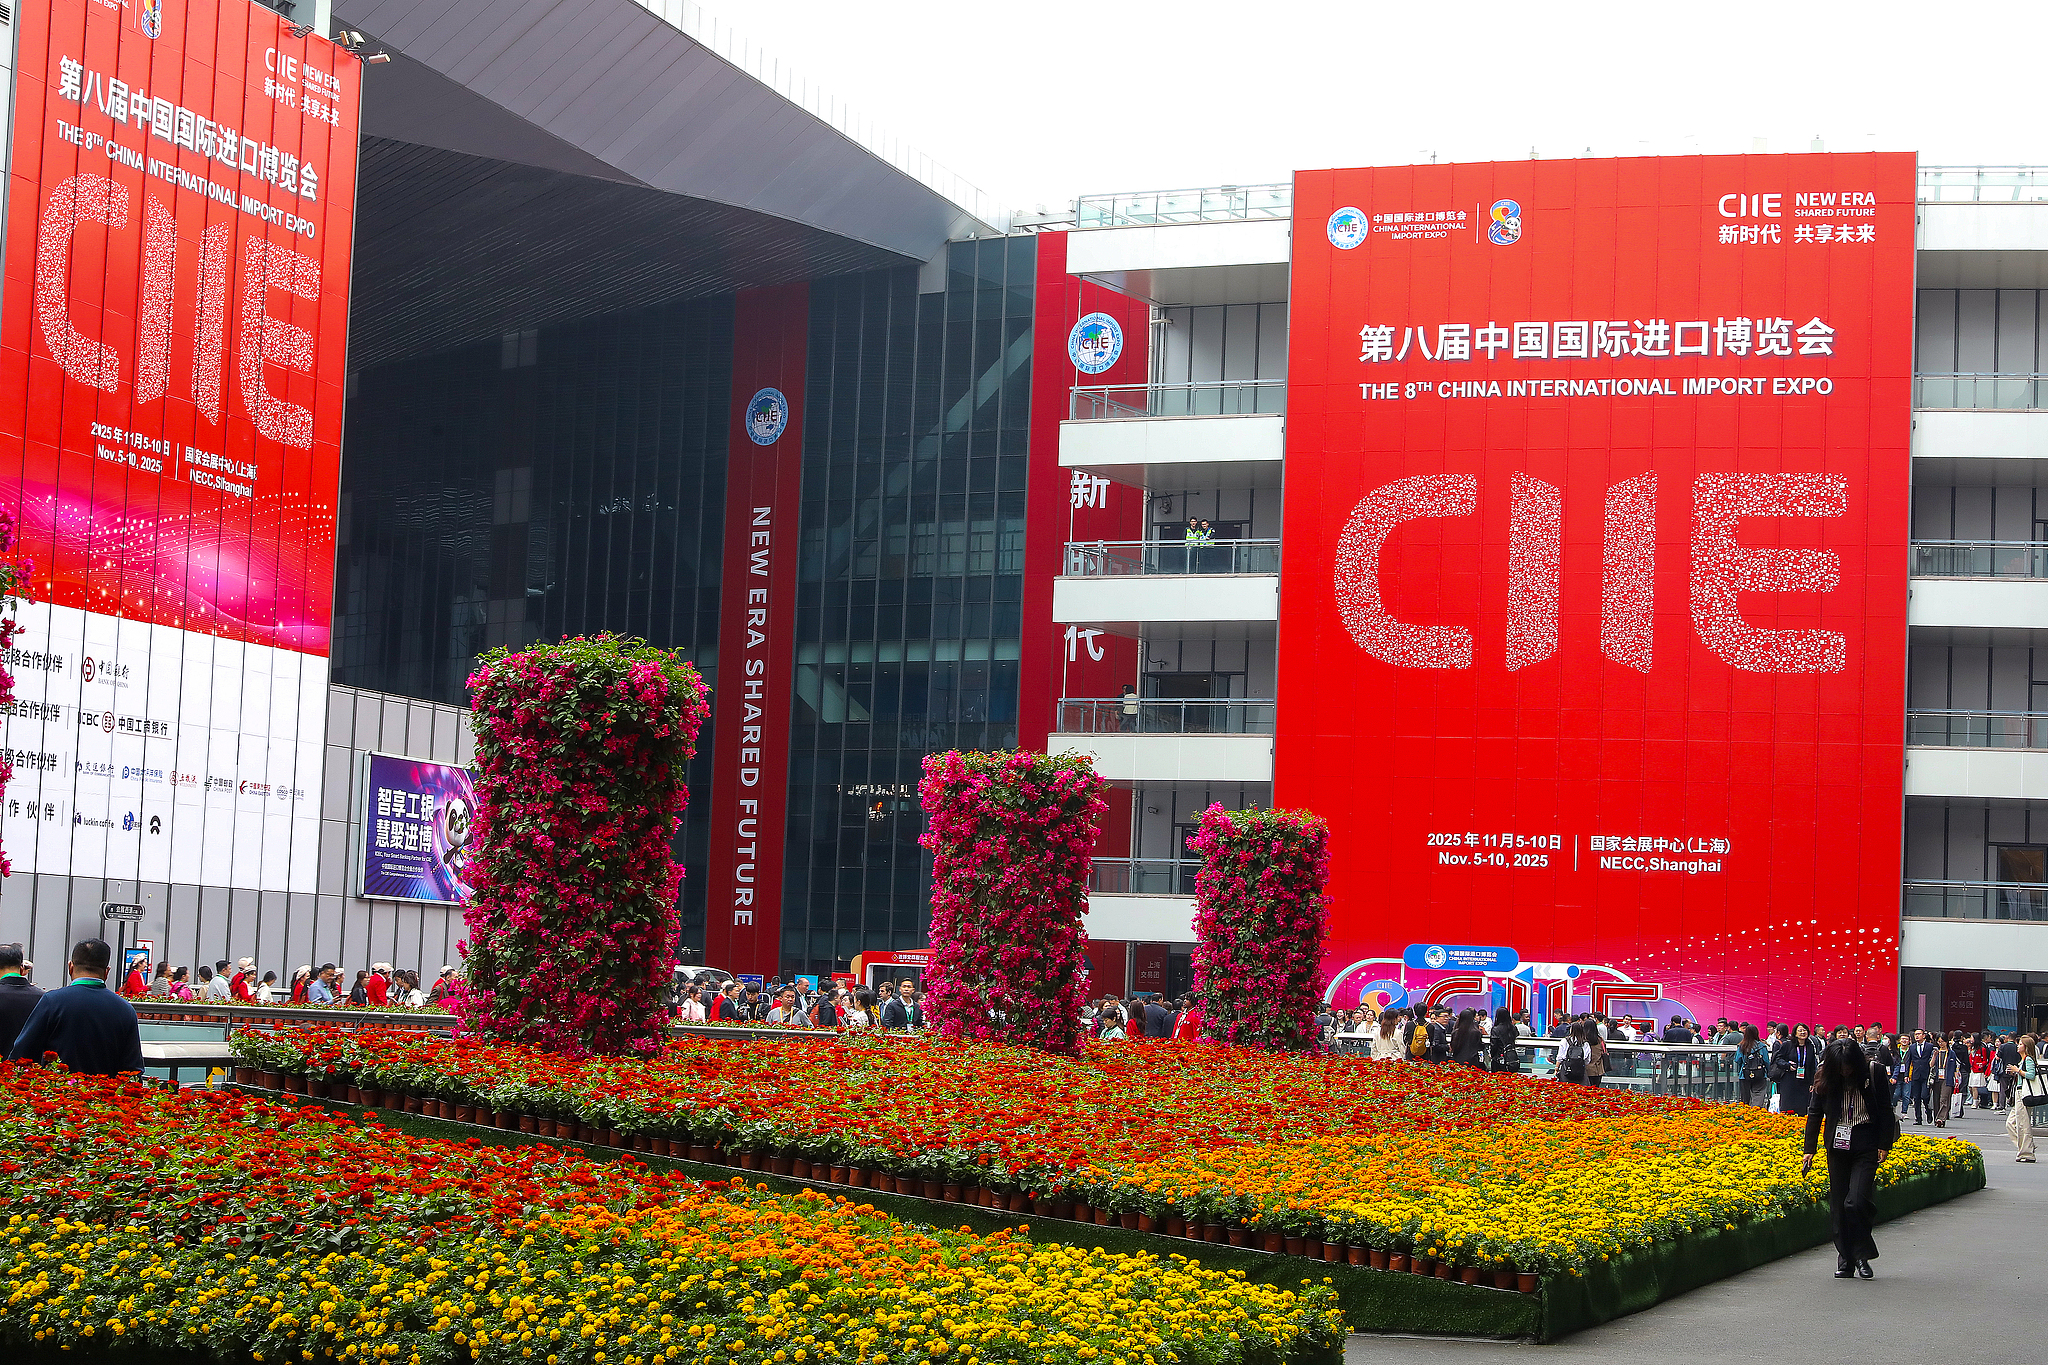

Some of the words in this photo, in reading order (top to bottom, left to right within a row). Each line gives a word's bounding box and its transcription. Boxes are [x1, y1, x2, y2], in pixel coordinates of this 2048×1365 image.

[265, 47, 298, 83] CIIE
[302, 62, 323, 84] NEW
[324, 73, 341, 93] ERA
[264, 76, 296, 108] 新时代
[300, 93, 340, 127] 共享未来
[58, 54, 320, 203] 第八届中国国际进口博览会
[57, 119, 84, 146] THE
[105, 140, 145, 172] CHINA
[147, 156, 240, 210] INTERNATIONAL
[241, 194, 285, 227] IMPORT
[285, 212, 316, 239] EXPO
[1718, 193, 1783, 218] CIIE
[1795, 192, 1837, 207] NEW
[1841, 191, 1876, 206] ERA
[1373, 210, 1467, 224] 中国国际进口博览会
[1794, 208, 1834, 218] SHARED
[1836, 207, 1876, 217] FUTURE
[1372, 224, 1400, 233] CHINA
[1401, 221, 1467, 232] INTERNATIONAL
[1391, 231, 1423, 240] IMPORT
[1424, 230, 1448, 239] EXPO
[1718, 223, 1782, 245] 新时代
[1793, 223, 1876, 244] 共享未来
[36, 172, 322, 451] CIIE
[1082, 337, 1109, 350] CIIE
[1358, 316, 1836, 363] 第八届中国国际进口博览会
[1359, 382, 1399, 400] THE
[1404, 381, 1433, 399] 8TH
[1437, 380, 1502, 398] CHINA
[1506, 378, 1677, 397] INTERNATIONAL
[1682, 377, 1767, 396] IMPORT
[1772, 377, 1834, 396] EXPO
[140, 456, 163, 474] 2025
[751, 506, 772, 577] NEW
[1333, 469, 1850, 674] CIIE
[746, 588, 767, 649] ERA
[118, 716, 168, 736] 中国工商银行
[740, 658, 765, 787] SHARED
[376, 786, 435, 823] 智享工银
[375, 818, 433, 853] 慧聚进博
[734, 799, 758, 926] FUTURE
[1513, 853, 1549, 868] 2025
[1377, 982, 1393, 990] CIIE
[1959, 989, 1974, 998] 上海
[1950, 1001, 1974, 1009] 交易团
